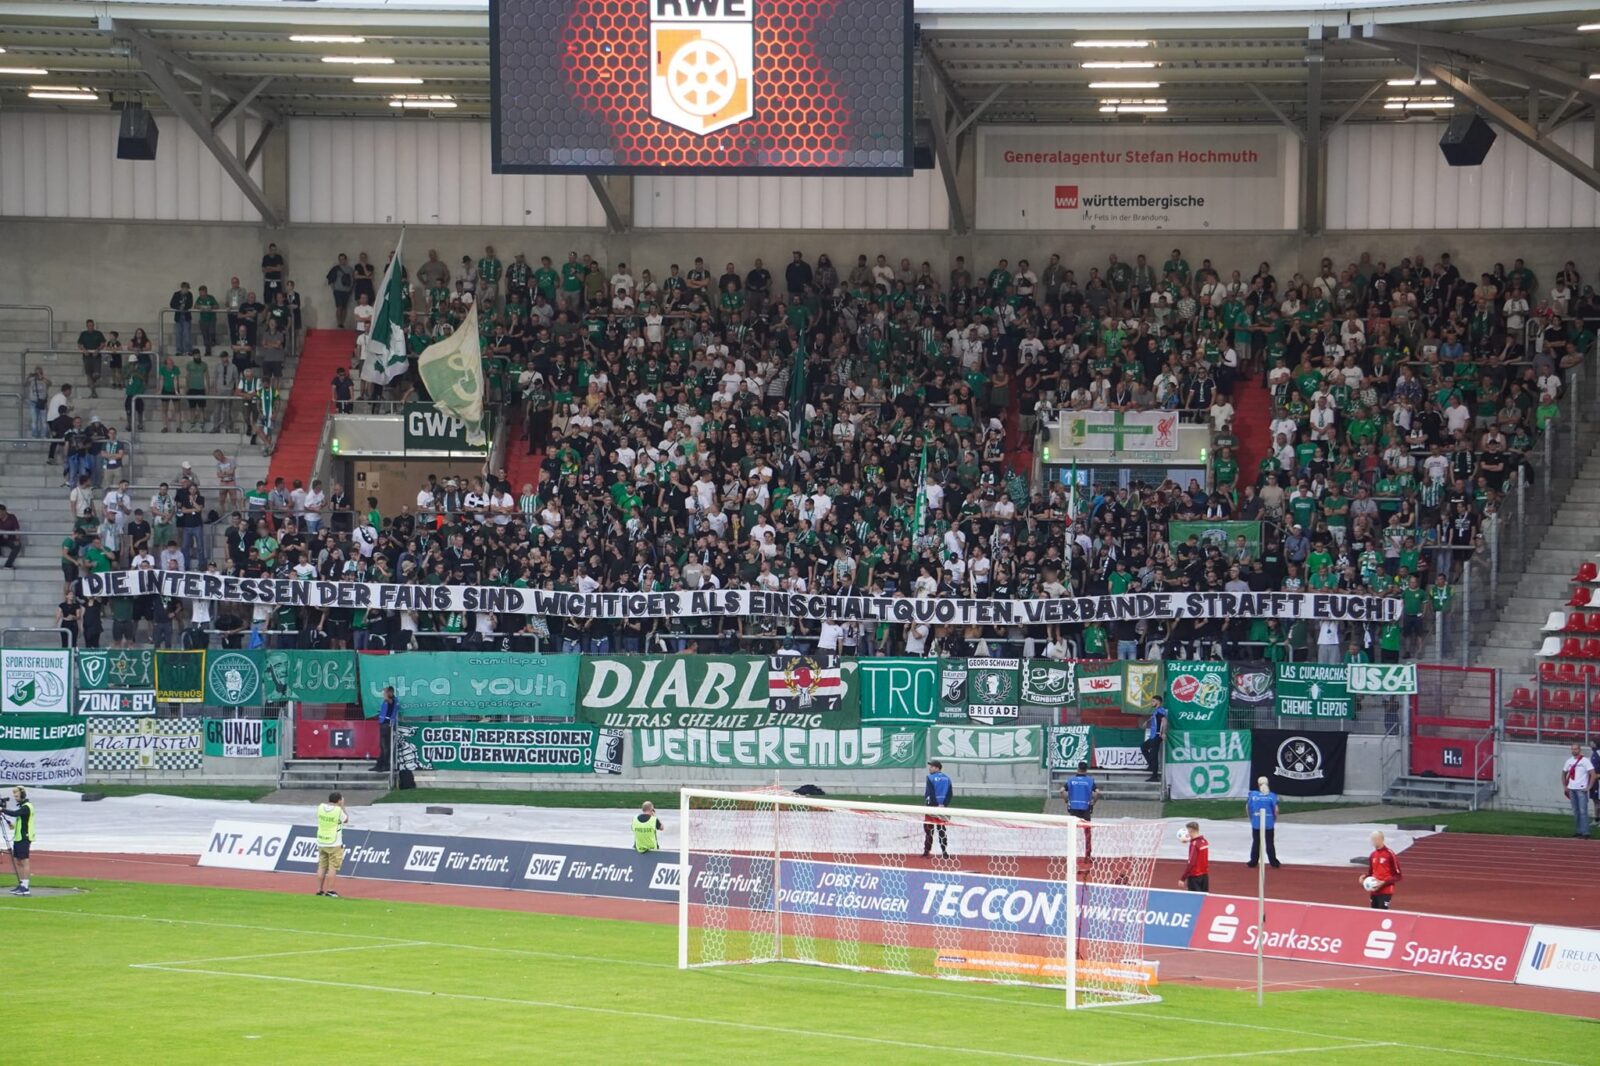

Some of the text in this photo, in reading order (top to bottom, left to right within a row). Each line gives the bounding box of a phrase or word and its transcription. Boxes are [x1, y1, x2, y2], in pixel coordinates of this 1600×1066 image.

[1004, 150, 1258, 165] Generalagentur Stefan Hochmuth
[1082, 194, 1205, 210] württembergische
[409, 411, 466, 437] GWP
[1155, 440, 1172, 448] LFC
[88, 572, 130, 595] DIE
[138, 571, 311, 605] INTERESSEN
[317, 582, 372, 607] DER
[379, 585, 453, 609] FANS
[463, 587, 524, 612] SIND
[534, 591, 681, 616] WICHTIGER
[691, 591, 743, 614] ALS
[750, 591, 1022, 623] EINSCHALTQUOTEN.
[1187, 592, 1304, 618] STRAFFT
[1313, 595, 1397, 621] EUCH!
[5, 656, 64, 669] SPORTSFREUNDE
[771, 656, 839, 670] U F
[969, 659, 1018, 668] GEORG SCHWARZ
[1168, 662, 1228, 672] Bierstand
[293, 658, 356, 690] 1964
[1281, 665, 1348, 681] LAS CUCARACHAS
[1351, 665, 1414, 690] US64
[470, 674, 568, 697] youth
[581, 659, 859, 709] DIABLS
[158, 688, 202, 698] PARVENÜS
[1030, 694, 1065, 703] KOMBINAT
[80, 694, 153, 711] ZONA 64
[775, 697, 838, 711] 9 7
[970, 705, 1017, 716] BRIGADE
[1281, 700, 1348, 716] CHEMIE LEIPZIG
[604, 713, 823, 728] ULTRAS CHEMIE LEIPZIG
[1178, 711, 1214, 720] Pöbel
[0, 723, 85, 740] CHEMIE LEIPZIG
[423, 729, 592, 744] GEGEN REPRESSIONEN
[938, 728, 1032, 758] SKINS
[423, 748, 455, 762] UND
[460, 744, 580, 764] ÜBERWACHUNG
[1096, 750, 1148, 766] WURZE
[1443, 750, 1462, 765] H1.1
[595, 762, 622, 771] LEIPZIG
[1190, 764, 1230, 794] 03
[350, 846, 391, 864] Erfurt.
[410, 849, 510, 873] SWE Für Erfurt.
[530, 858, 634, 883] SWE Für Erfurt.
[694, 871, 717, 888] Für
[719, 873, 762, 893] Erfurt.
[817, 872, 879, 889] JOBS FÜR
[778, 888, 909, 912] DIGITALE LÖSUNGEN
[921, 882, 1062, 925] TECCON
[1242, 925, 1342, 954] Sparkasse
[1401, 941, 1507, 971] Sparkasse
